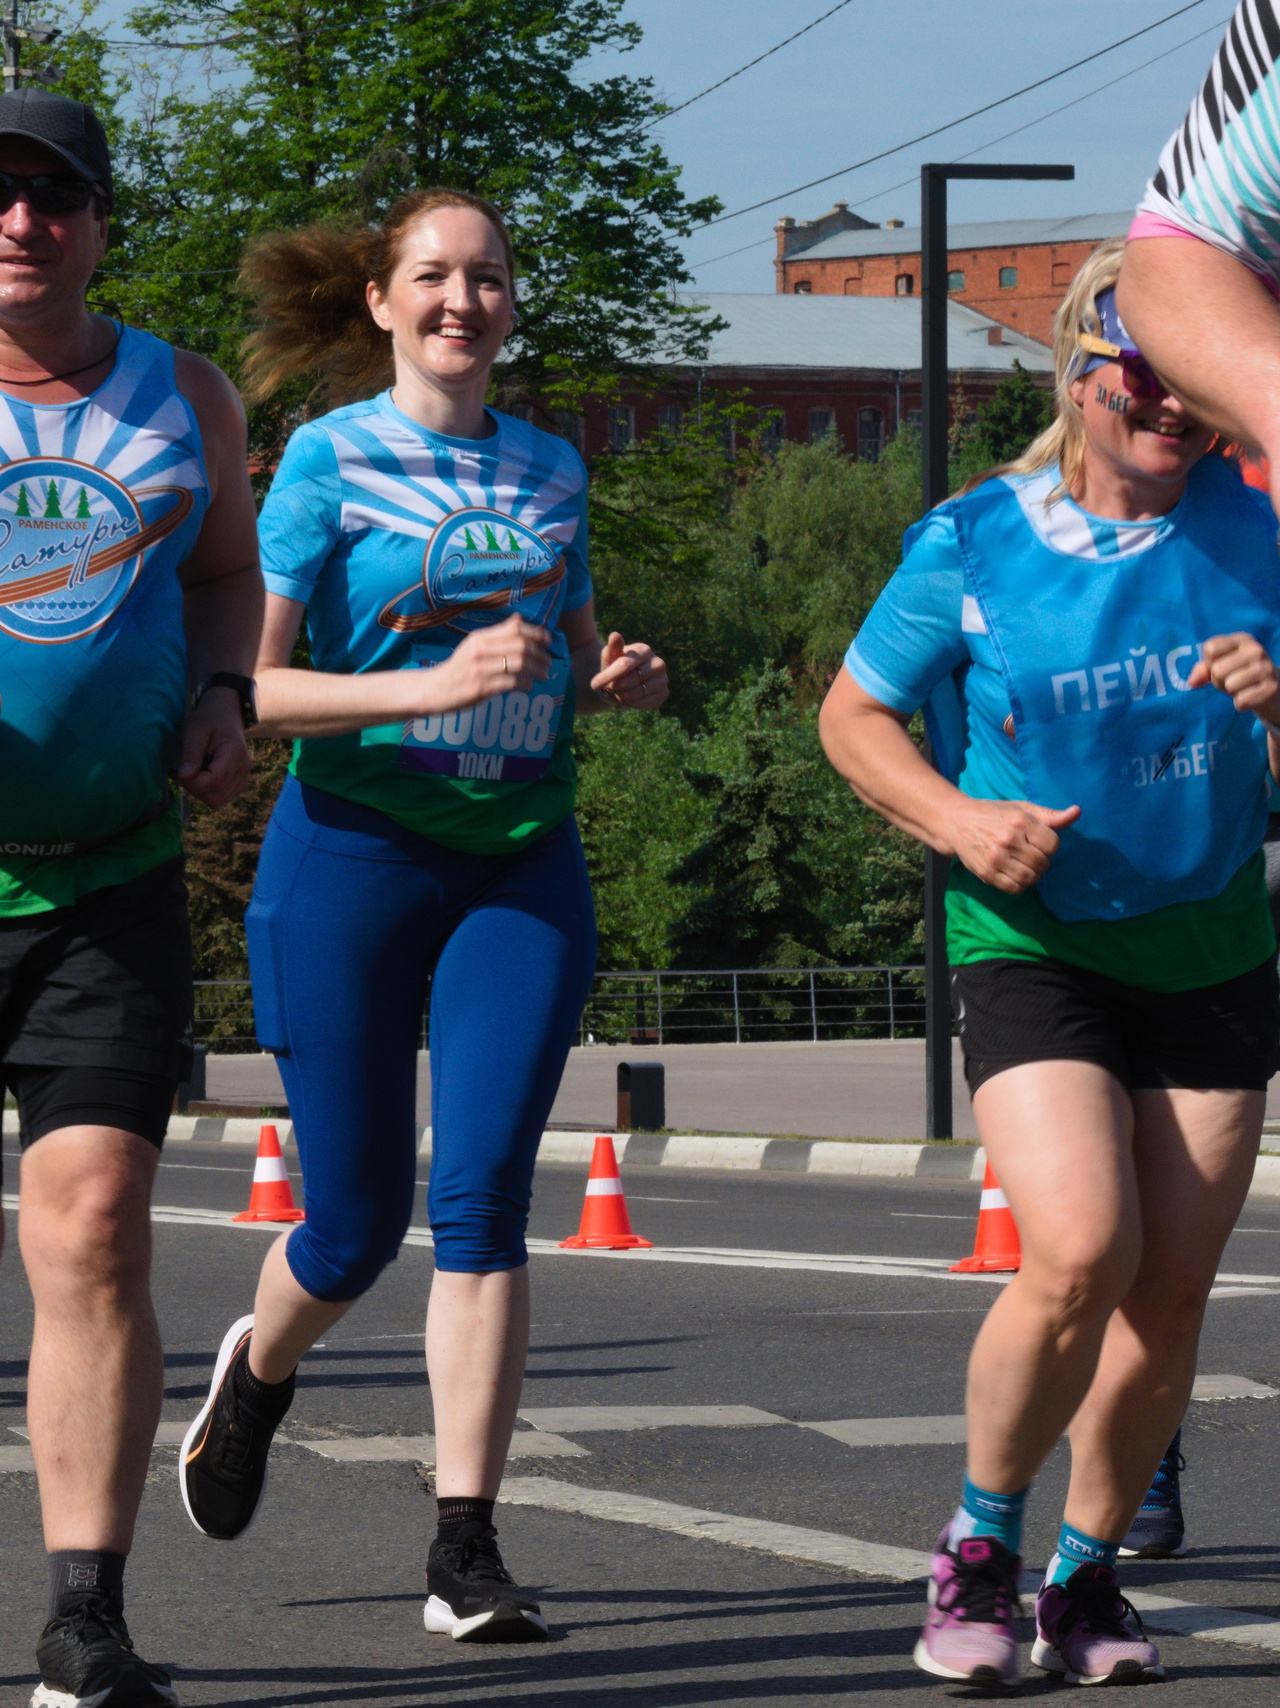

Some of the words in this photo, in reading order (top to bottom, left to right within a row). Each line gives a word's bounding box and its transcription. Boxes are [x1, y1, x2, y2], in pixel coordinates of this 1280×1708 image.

[18, 519, 89, 531] РАМЕНСКОЕ
[468, 551, 521, 561] РАМЕНСКОЕ
[432, 549, 554, 607] Сатурн
[1051, 643, 1204, 714] ПЕЙС
[457, 752, 504, 780] 10KM
